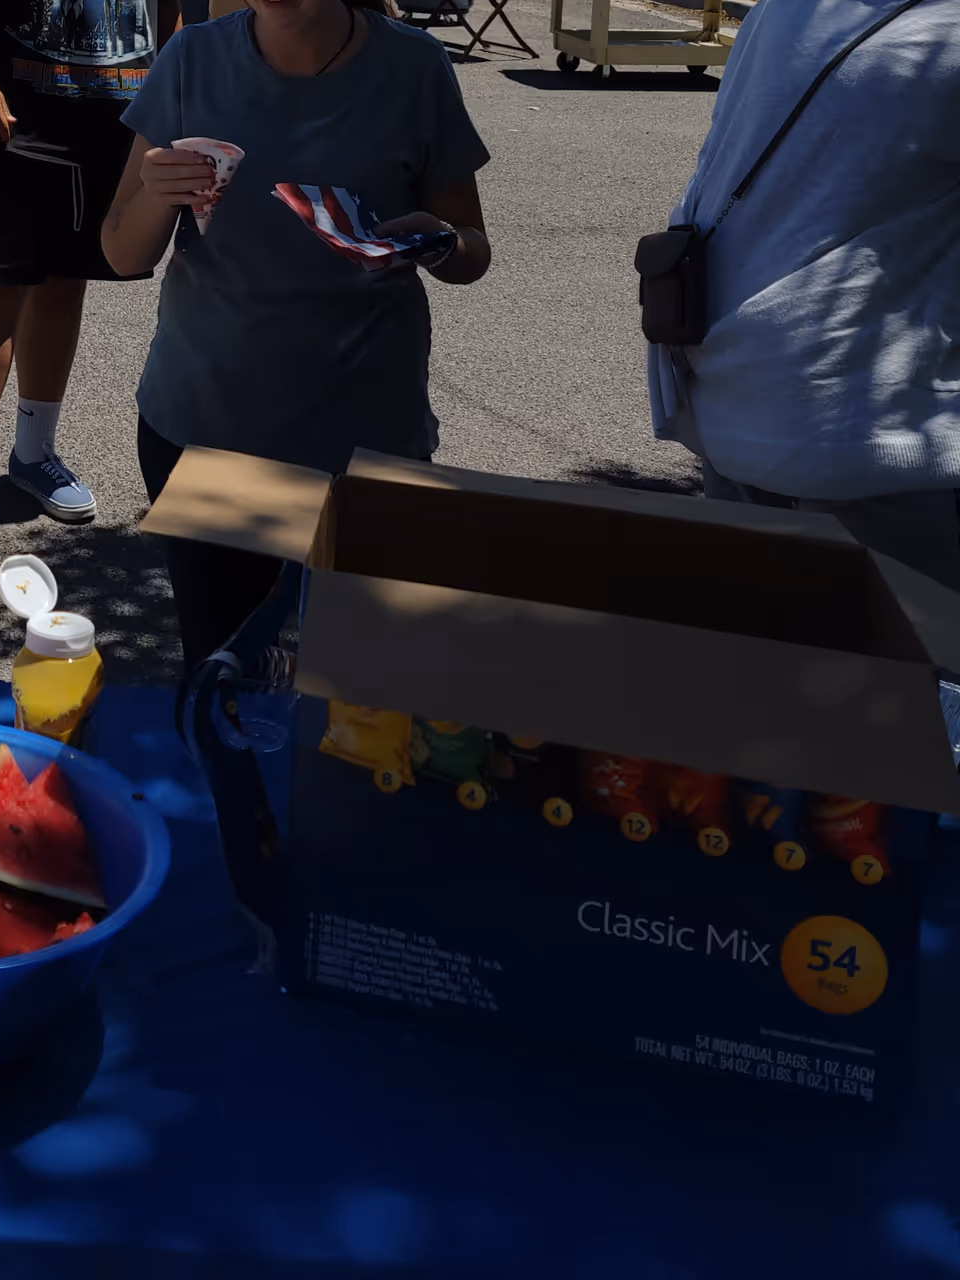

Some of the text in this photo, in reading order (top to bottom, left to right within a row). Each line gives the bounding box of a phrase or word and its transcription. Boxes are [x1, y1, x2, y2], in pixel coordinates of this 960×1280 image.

[464, 788, 476, 802] 4
[551, 804, 563, 819] 4
[626, 819, 646, 835] 12
[704, 834, 724, 850] 12
[785, 849, 797, 864] 7
[863, 862, 875, 877] 7
[577, 899, 772, 967] Classic Mix
[806, 938, 862, 978] 54
[634, 1035, 668, 1058] TOTAL
[671, 1044, 692, 1063] NET
[719, 1055, 734, 1072] 54
[834, 1077, 858, 1096] 1.53
[695, 1033, 710, 1050] 54
[712, 1037, 774, 1064] INDIVIDUAL
[815, 1058, 821, 1073] 1
[846, 1064, 876, 1084] EACH
